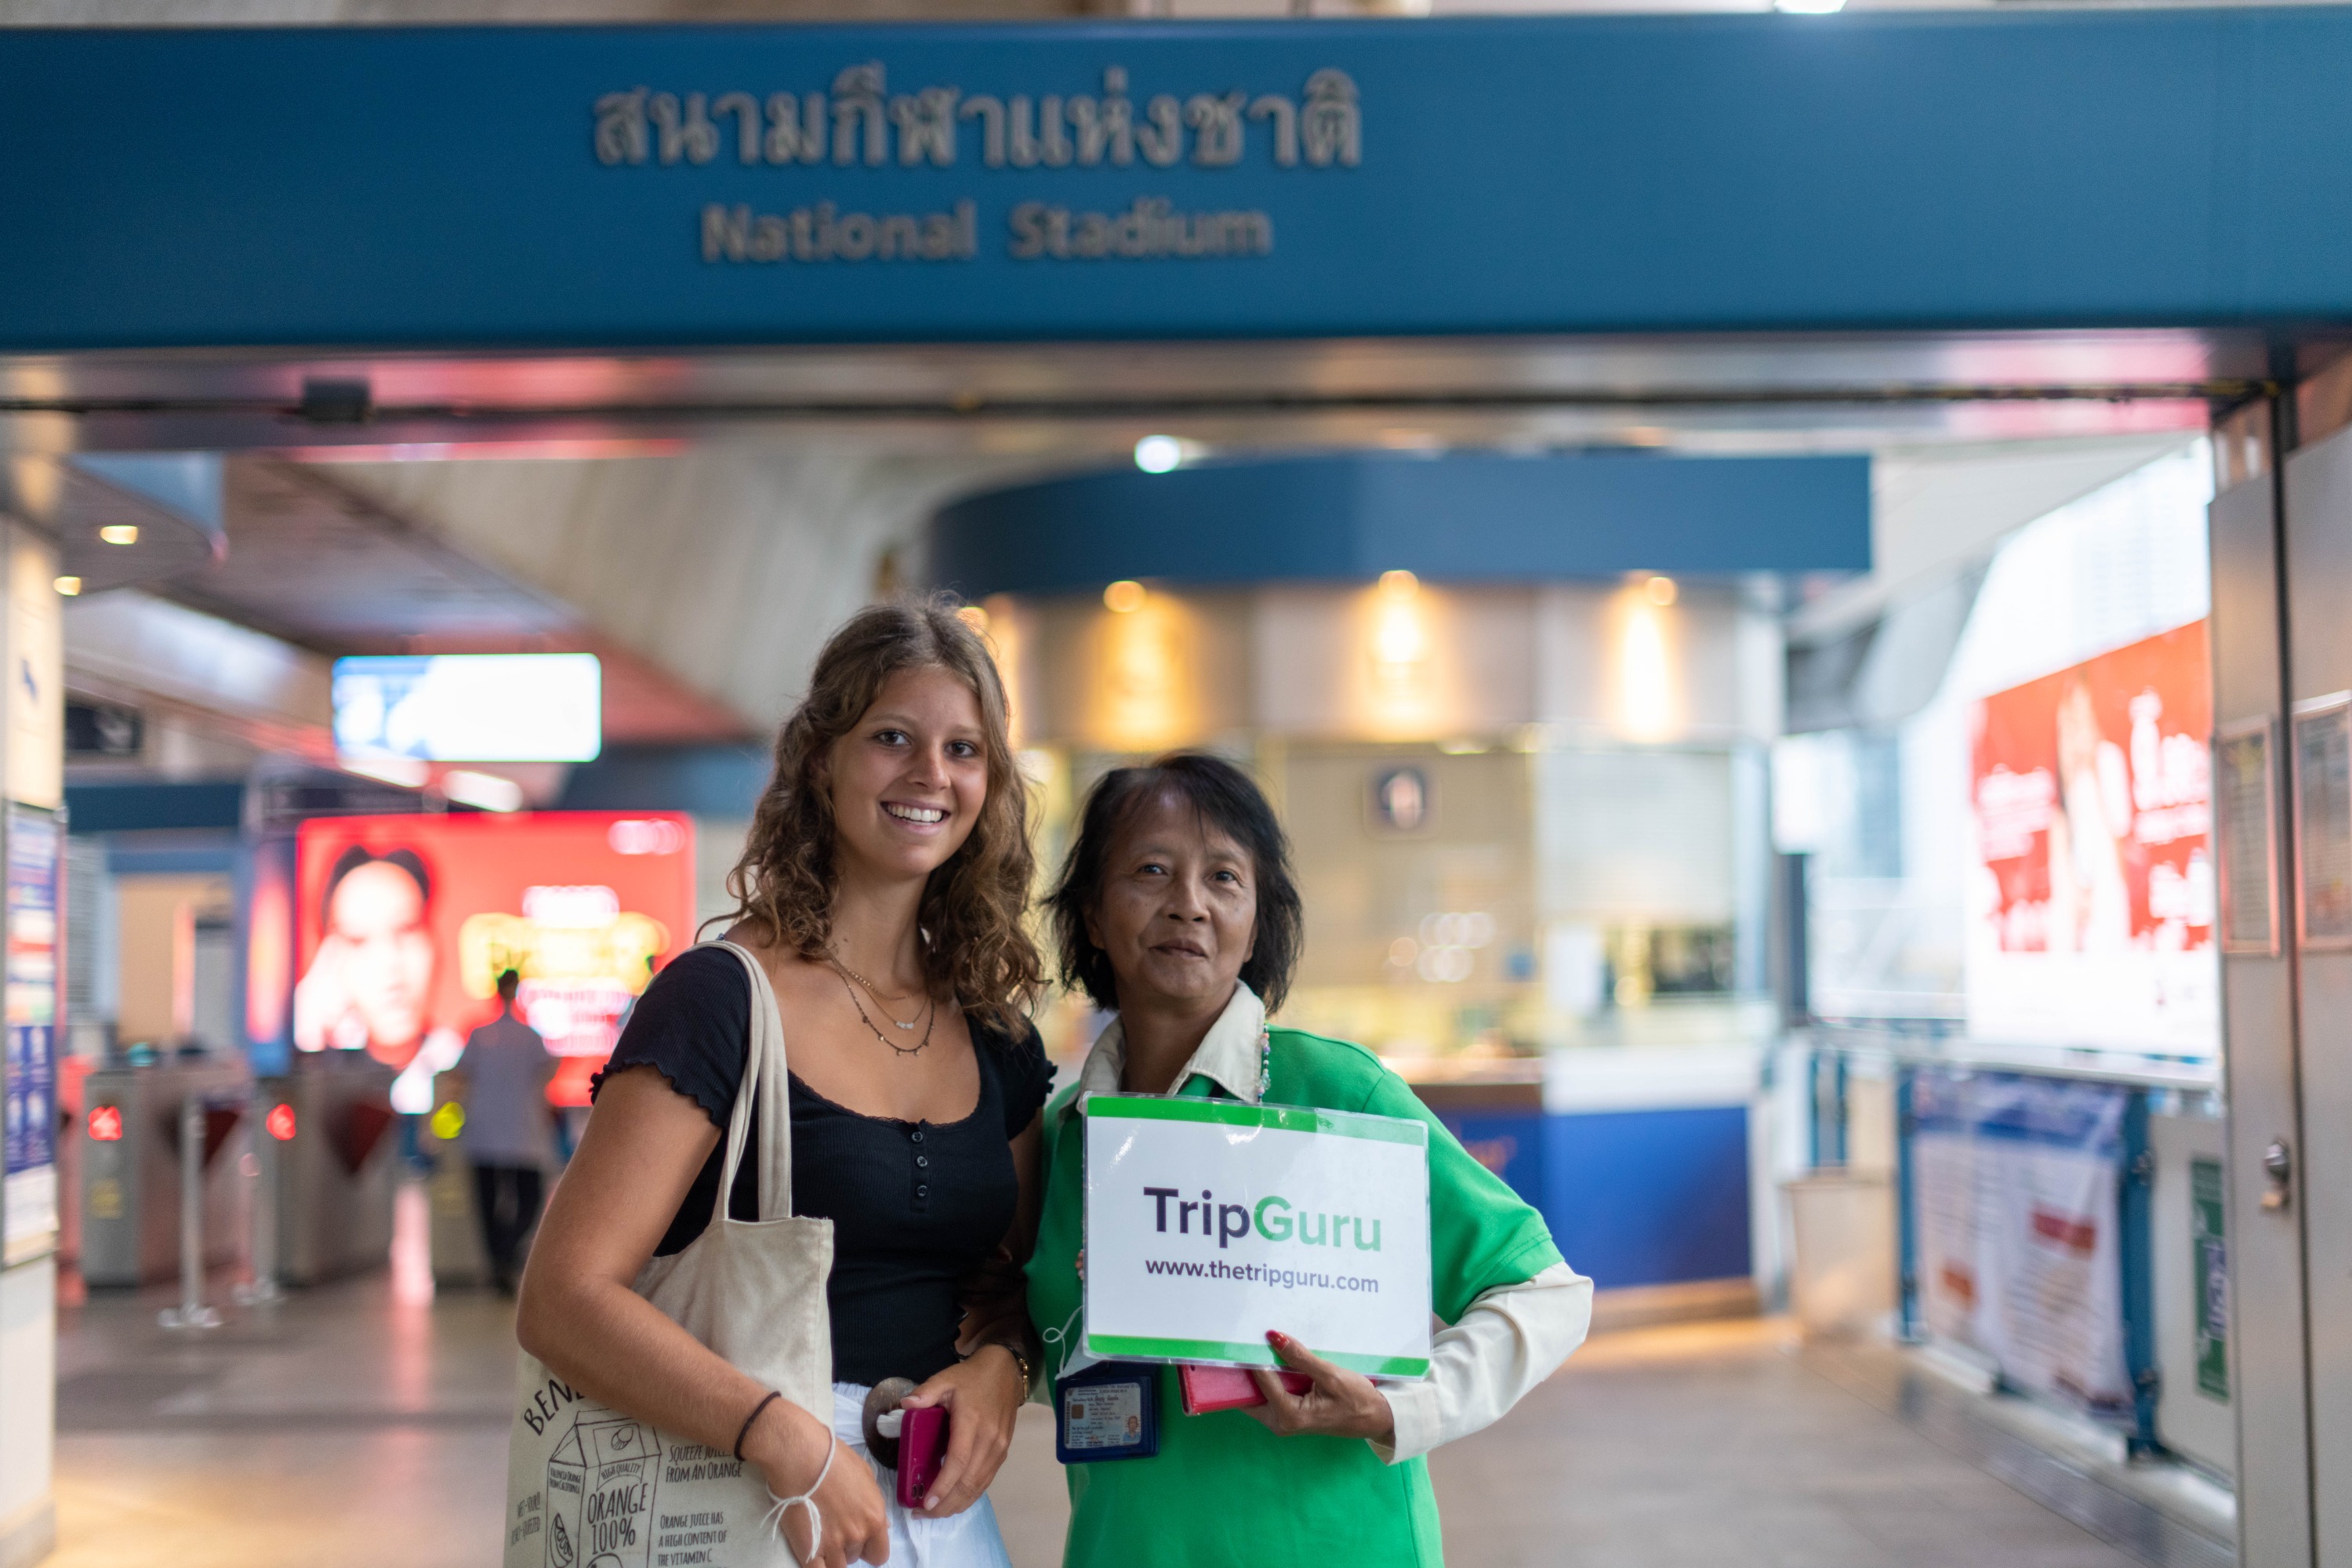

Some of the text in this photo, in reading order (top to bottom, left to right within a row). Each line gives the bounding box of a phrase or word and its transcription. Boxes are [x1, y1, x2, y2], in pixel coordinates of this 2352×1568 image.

[594, 60, 1362, 166] สนามกีฬาแห่งชาติ
[702, 196, 1273, 263] National Stadium
[1143, 1186, 1381, 1252] TripGuru
[1145, 1259, 1379, 1293] www.thetripguru.com
[669, 1445, 703, 1465] SQUEEZE
[601, 1462, 642, 1481] HIGH QUALITY
[666, 1461, 742, 1483] FROM AN ORANGE
[587, 1483, 649, 1525] ORANGE
[660, 1512, 724, 1530] ORANGE JUICE HAS
[591, 1516, 637, 1555] 100%
[659, 1530, 728, 1548] A HIGH CONTENT OF
[658, 1548, 713, 1567] THE VITAMIN C
